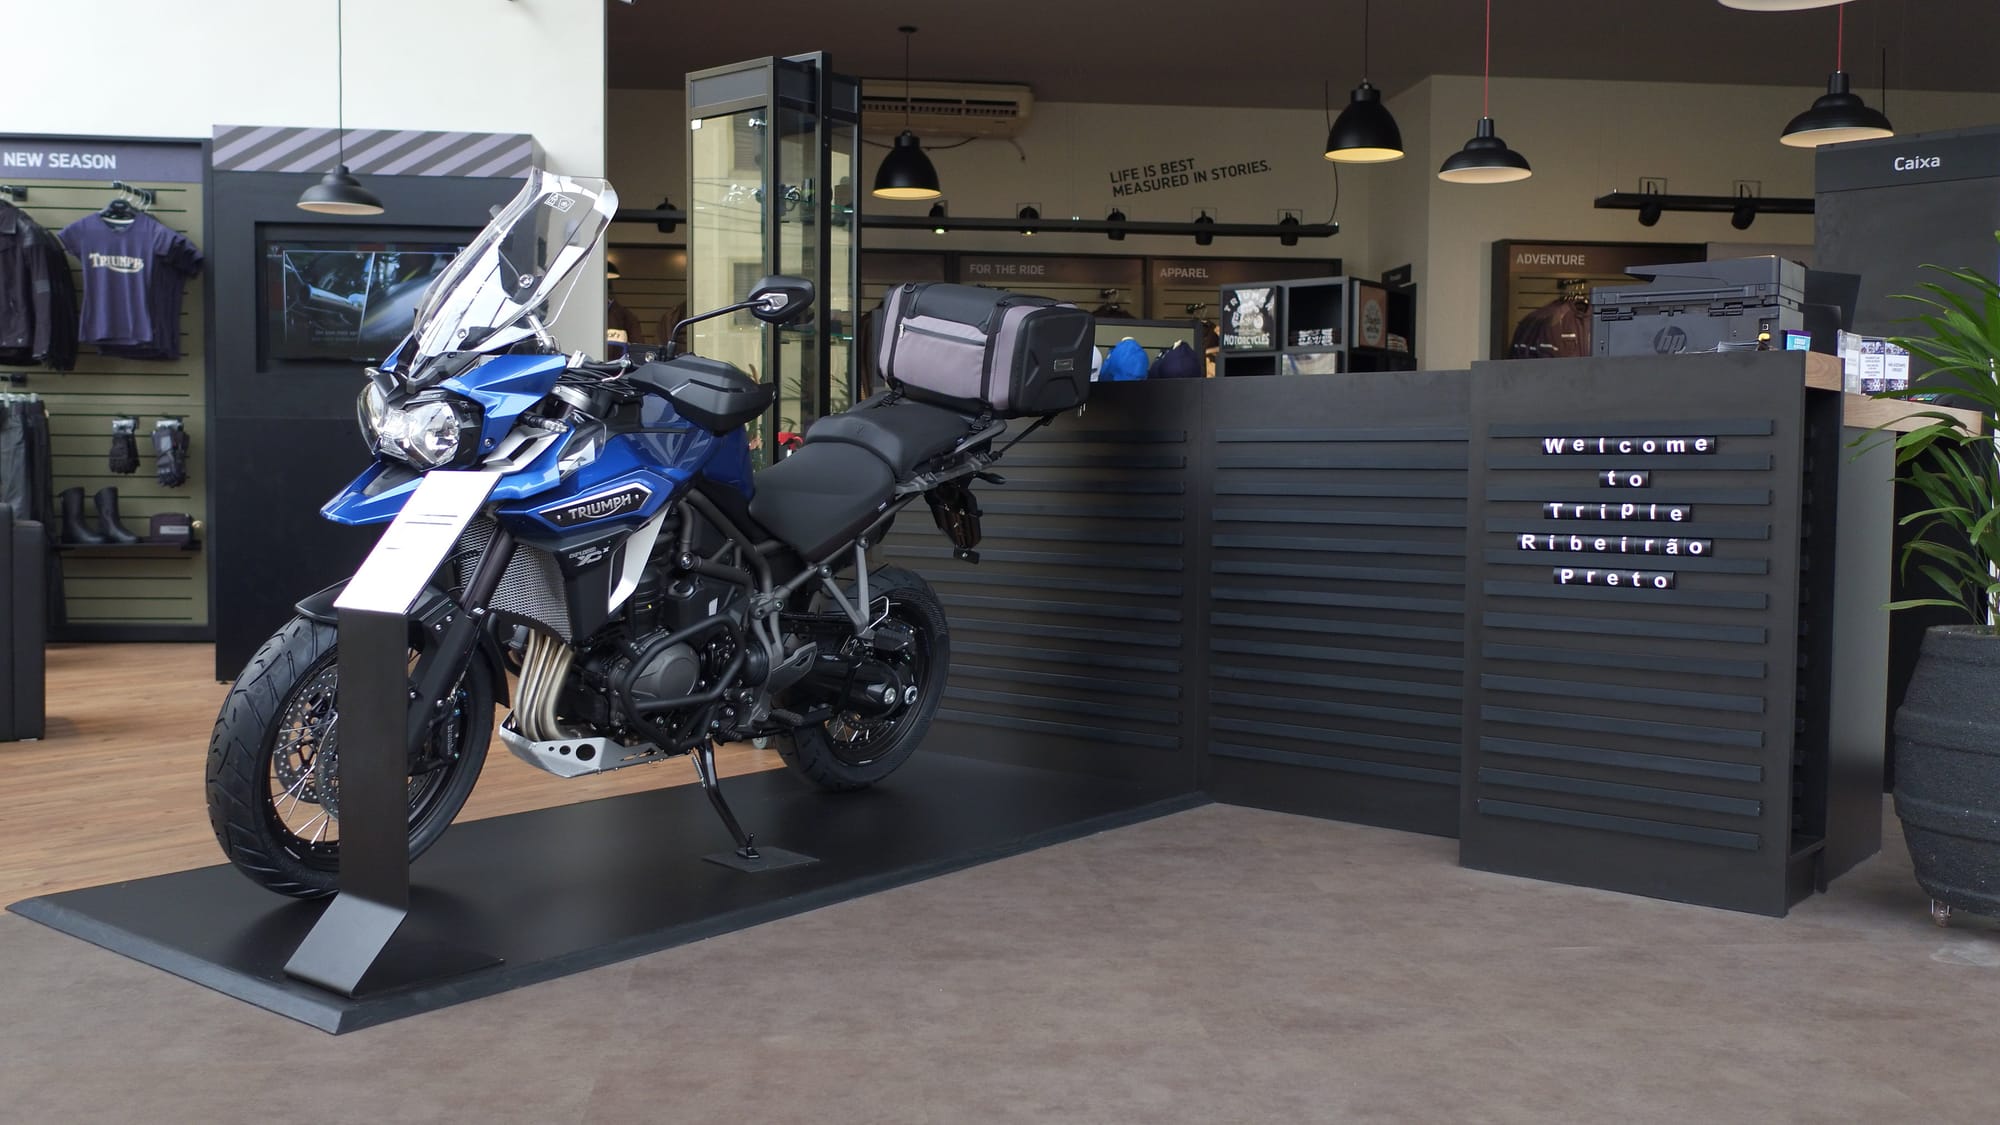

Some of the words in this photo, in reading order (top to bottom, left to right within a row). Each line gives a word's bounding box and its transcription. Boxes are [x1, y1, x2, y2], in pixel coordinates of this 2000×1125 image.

[3, 152, 44, 167] NEW
[48, 153, 117, 169] SEASON
[1894, 155, 1940, 171] Caixa
[1110, 168, 1140, 184] LIFE
[1143, 165, 1157, 178] IS
[1160, 158, 1195, 175] BEST
[1113, 174, 1189, 198] MEASURED
[1194, 170, 1208, 184] IN
[1212, 160, 1272, 181] STORIES.
[1516, 253, 1585, 265] ADVENTURE
[969, 263, 991, 274] FOR
[995, 264, 1017, 274] THE
[1019, 264, 1045, 275] RIDE
[1160, 267, 1209, 278] APPAREL
[1223, 286, 1275, 312] TRUMPH
[1223, 333, 1270, 346] MOTORCYCLES
[1656, 327, 1687, 354] hp
[1544, 437, 1708, 454] Welcome
[1607, 470, 1643, 487] to
[567, 493, 632, 520] TRIUMPH
[1549, 502, 1683, 522] Triple
[1521, 534, 1703, 555] Ribeirão
[1560, 568, 1668, 589] Preto
